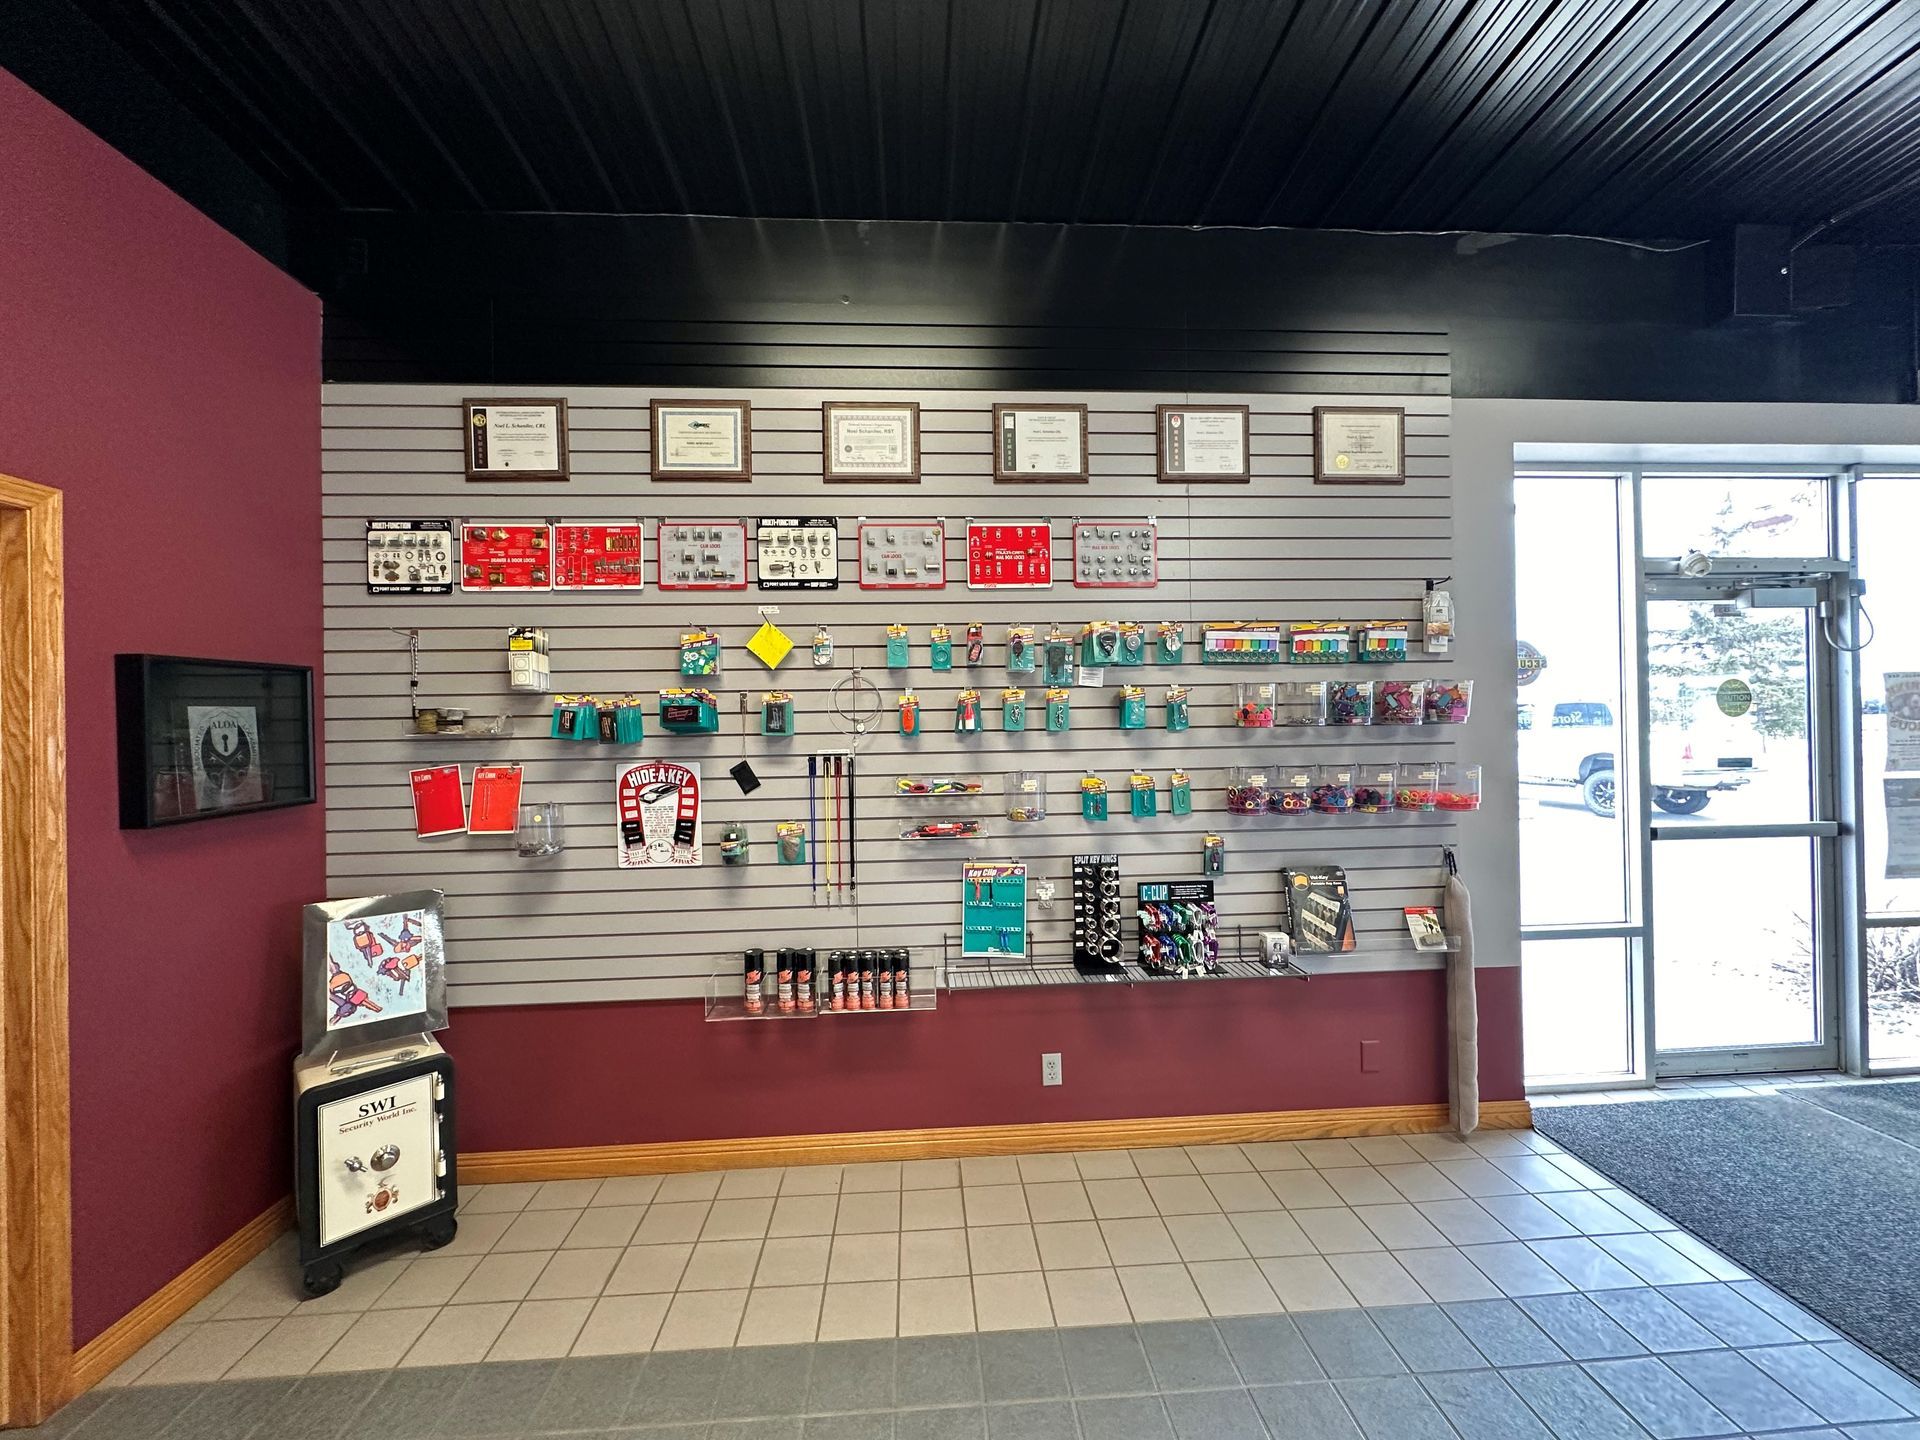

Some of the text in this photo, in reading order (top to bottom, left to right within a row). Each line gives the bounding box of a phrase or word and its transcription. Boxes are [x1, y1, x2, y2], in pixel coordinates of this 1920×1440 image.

[211, 720, 237, 729] ALOA
[1074, 854, 1118, 864] SPLIT KEY RINGS
[968, 868, 997, 877] Key Clip
[1142, 885, 1168, 901] C-CLIP
[358, 1095, 397, 1118] SWI
[338, 1107, 417, 1135] Security World Inc.
